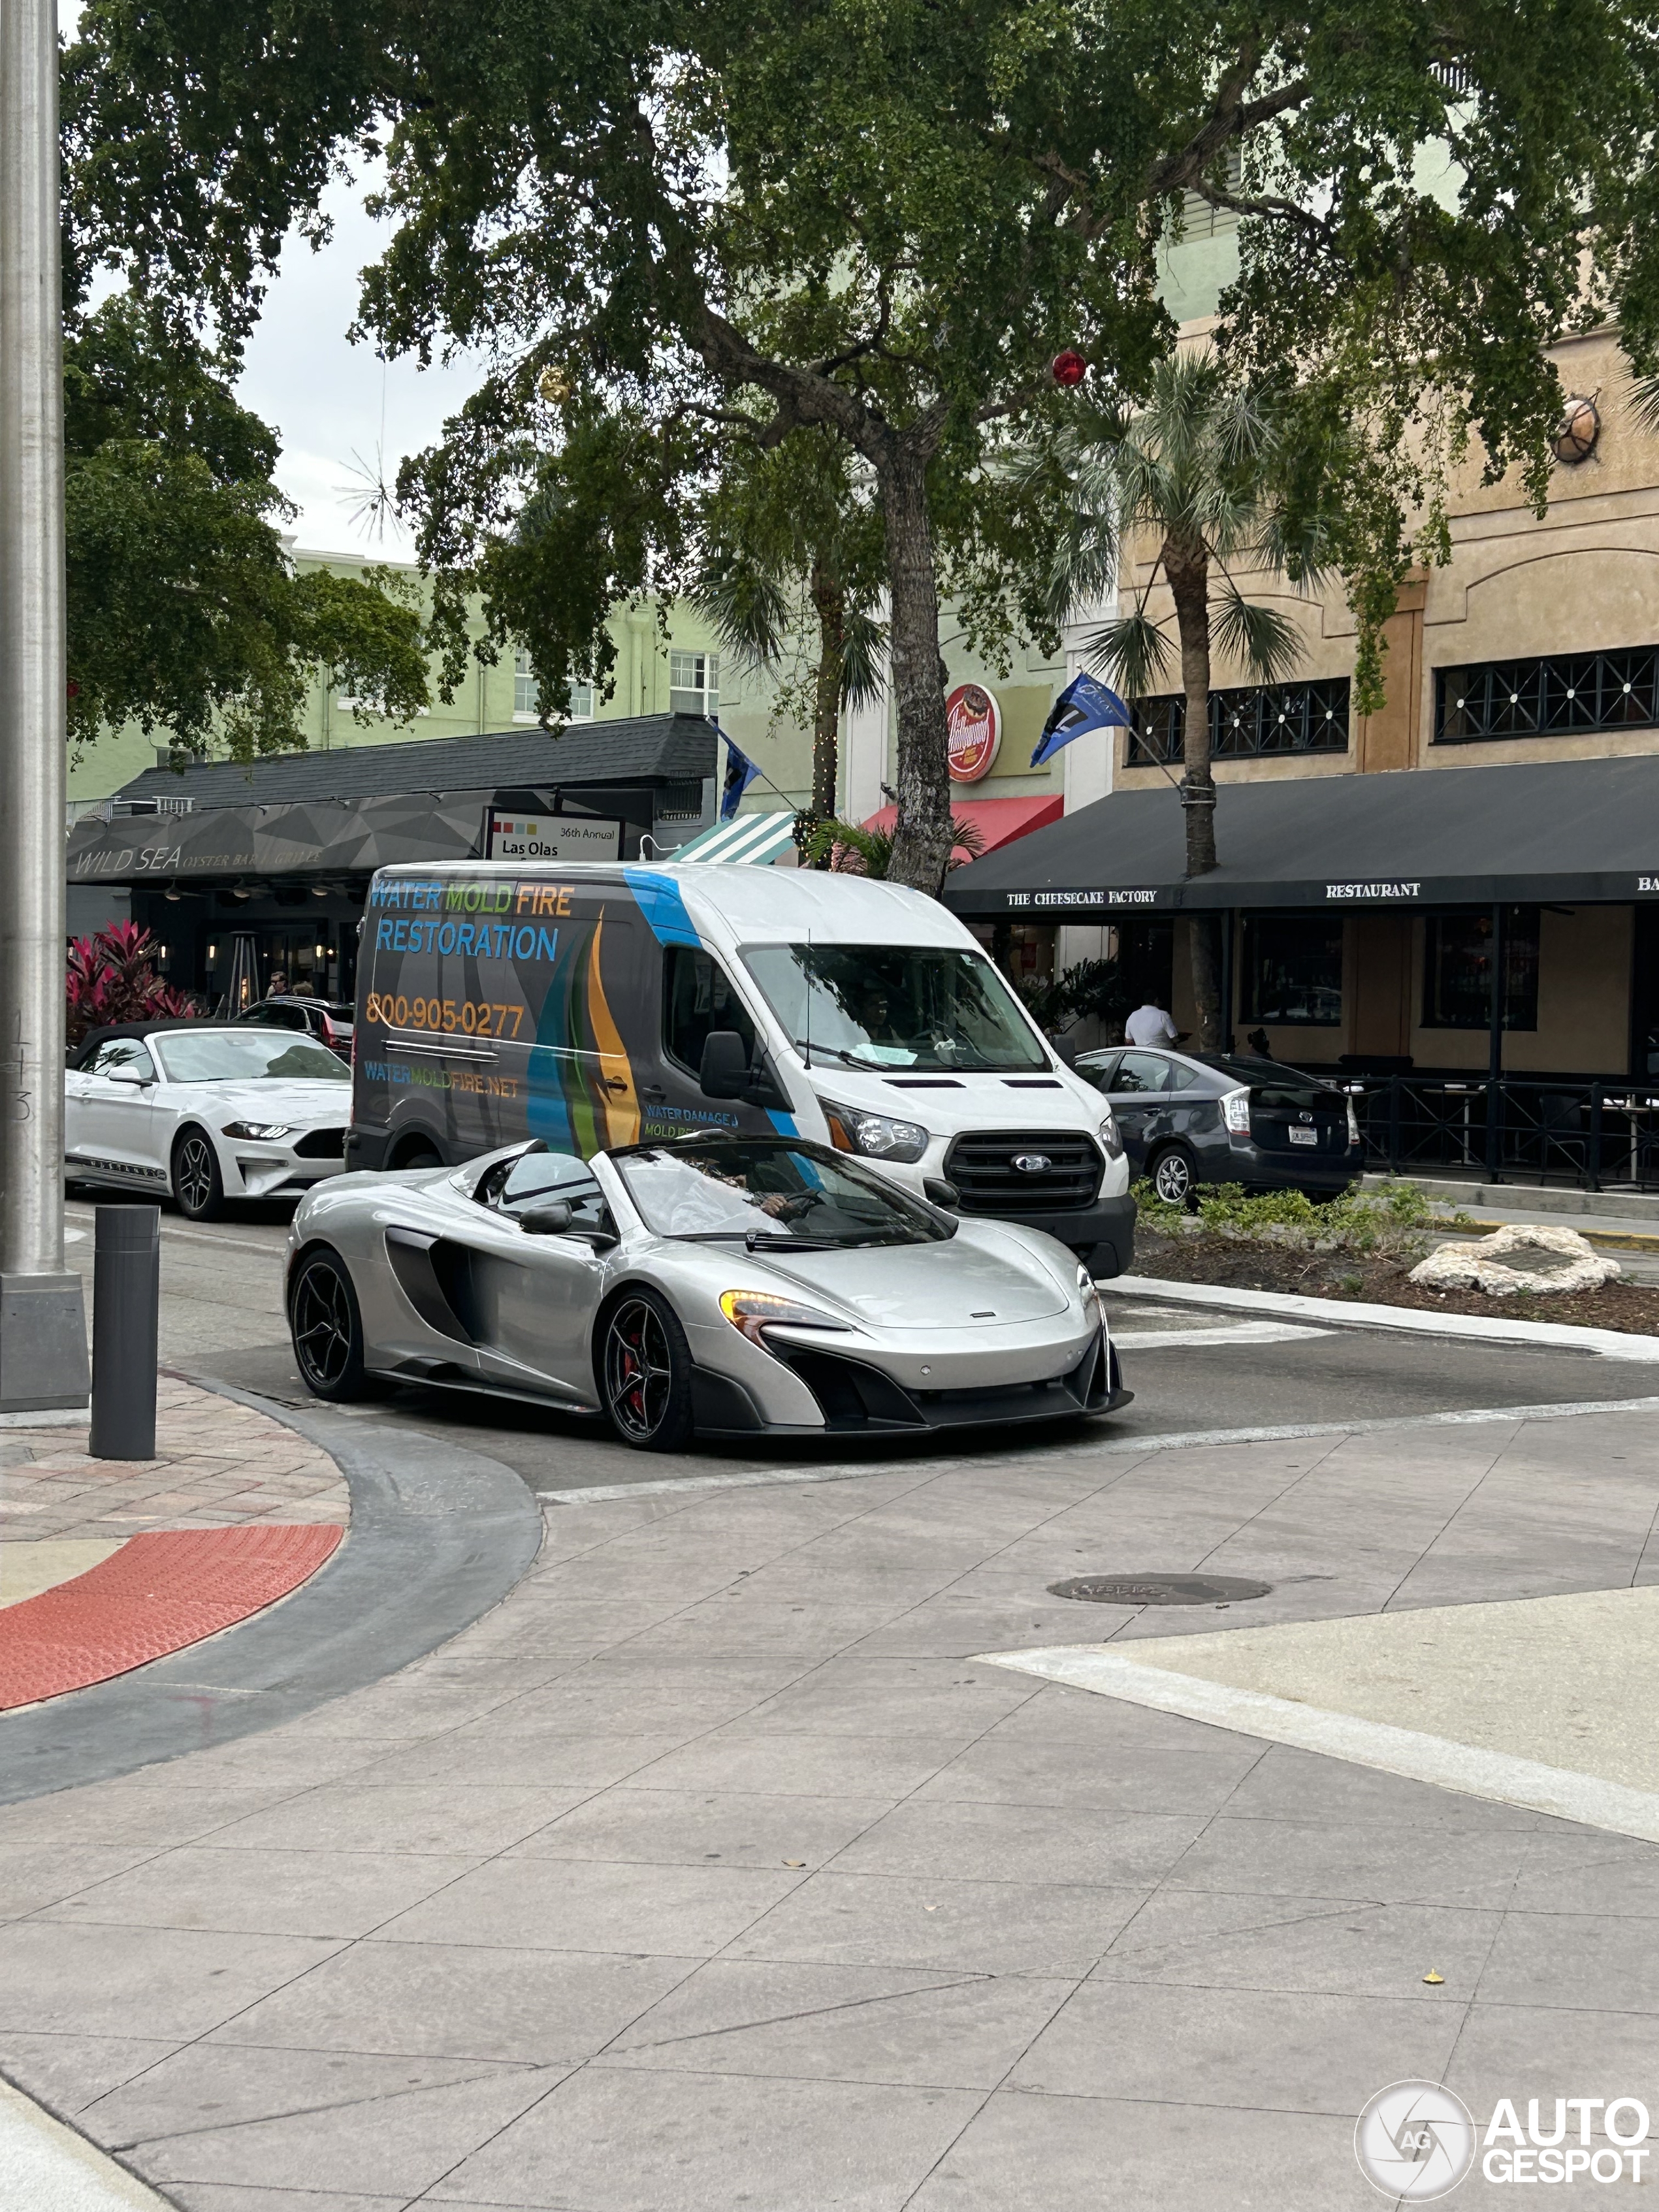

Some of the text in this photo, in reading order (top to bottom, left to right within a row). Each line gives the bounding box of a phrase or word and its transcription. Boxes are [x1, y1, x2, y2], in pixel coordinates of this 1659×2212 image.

[583, 829, 615, 840] Annual
[502, 841, 558, 856] Las Olas
[75, 844, 182, 874] WILD SEA
[233, 854, 257, 866] BAR
[371, 880, 575, 916] WATER MOLD FIRE
[1007, 890, 1157, 906] THE CHEESECAKE FACTORY
[1326, 883, 1421, 898] RESTAURANT
[377, 918, 558, 961] RESTORATION
[366, 993, 524, 1038] 800-905-0277
[364, 1060, 519, 1098] WATERMOLDFIRE.NET
[645, 1105, 730, 1126] WATER DAMAGE
[645, 1123, 676, 1138] MOLD
